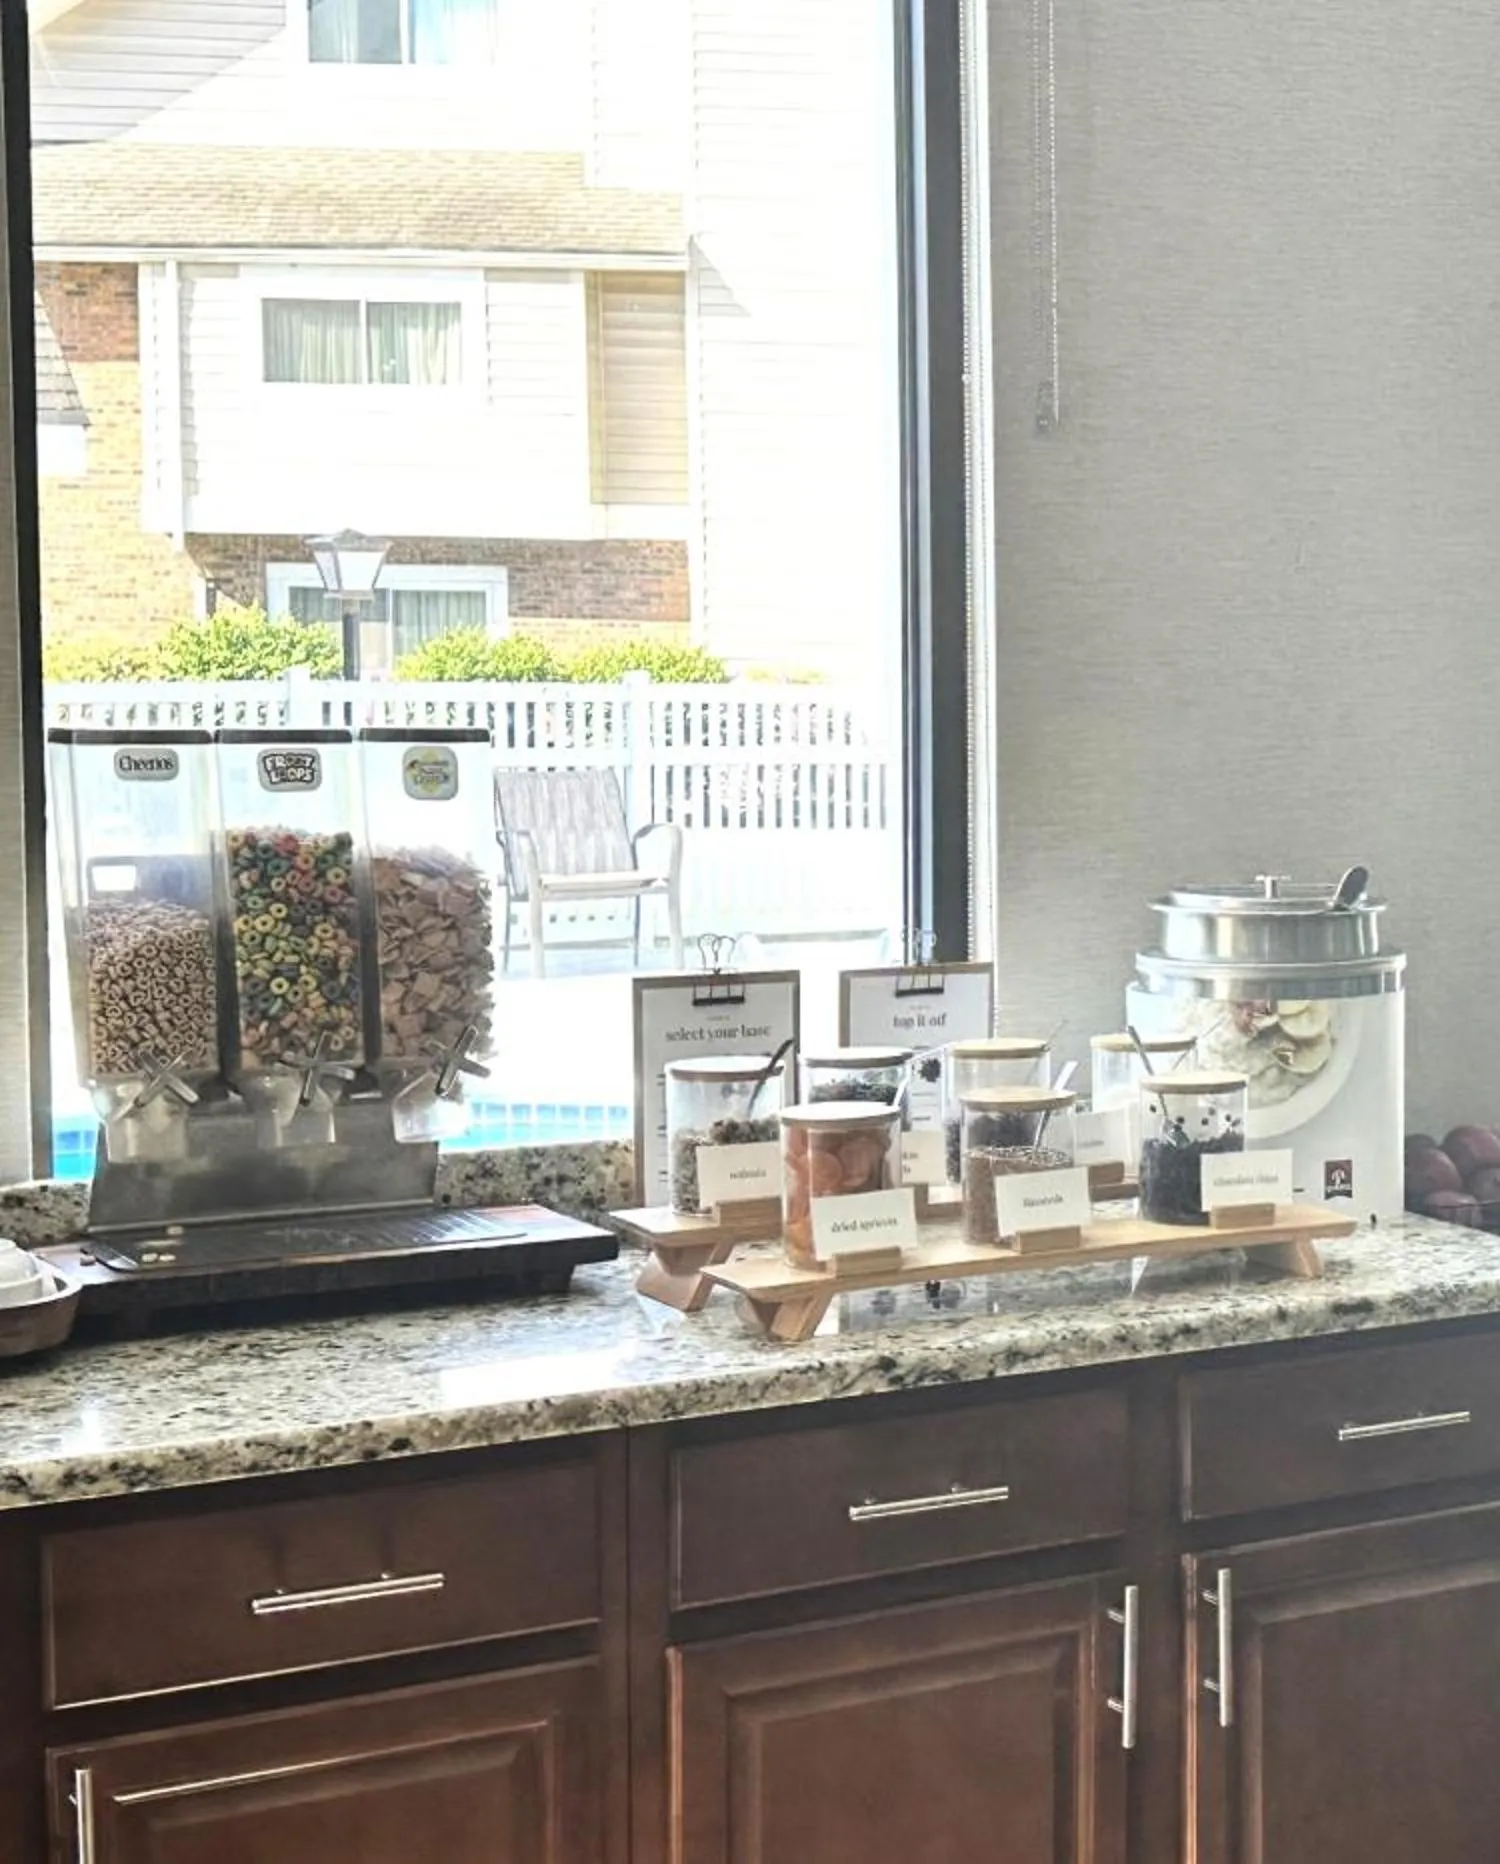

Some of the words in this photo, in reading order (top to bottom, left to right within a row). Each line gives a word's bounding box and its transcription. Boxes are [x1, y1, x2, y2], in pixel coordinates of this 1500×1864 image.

[119, 755, 174, 771] Cheerios
[270, 767, 313, 783] LOOPS
[893, 1013, 915, 1031] top
[917, 1013, 925, 1028] it
[929, 1012, 947, 1028] off
[665, 1025, 704, 1041] select
[706, 1026, 739, 1043] your
[740, 1023, 771, 1037] base
